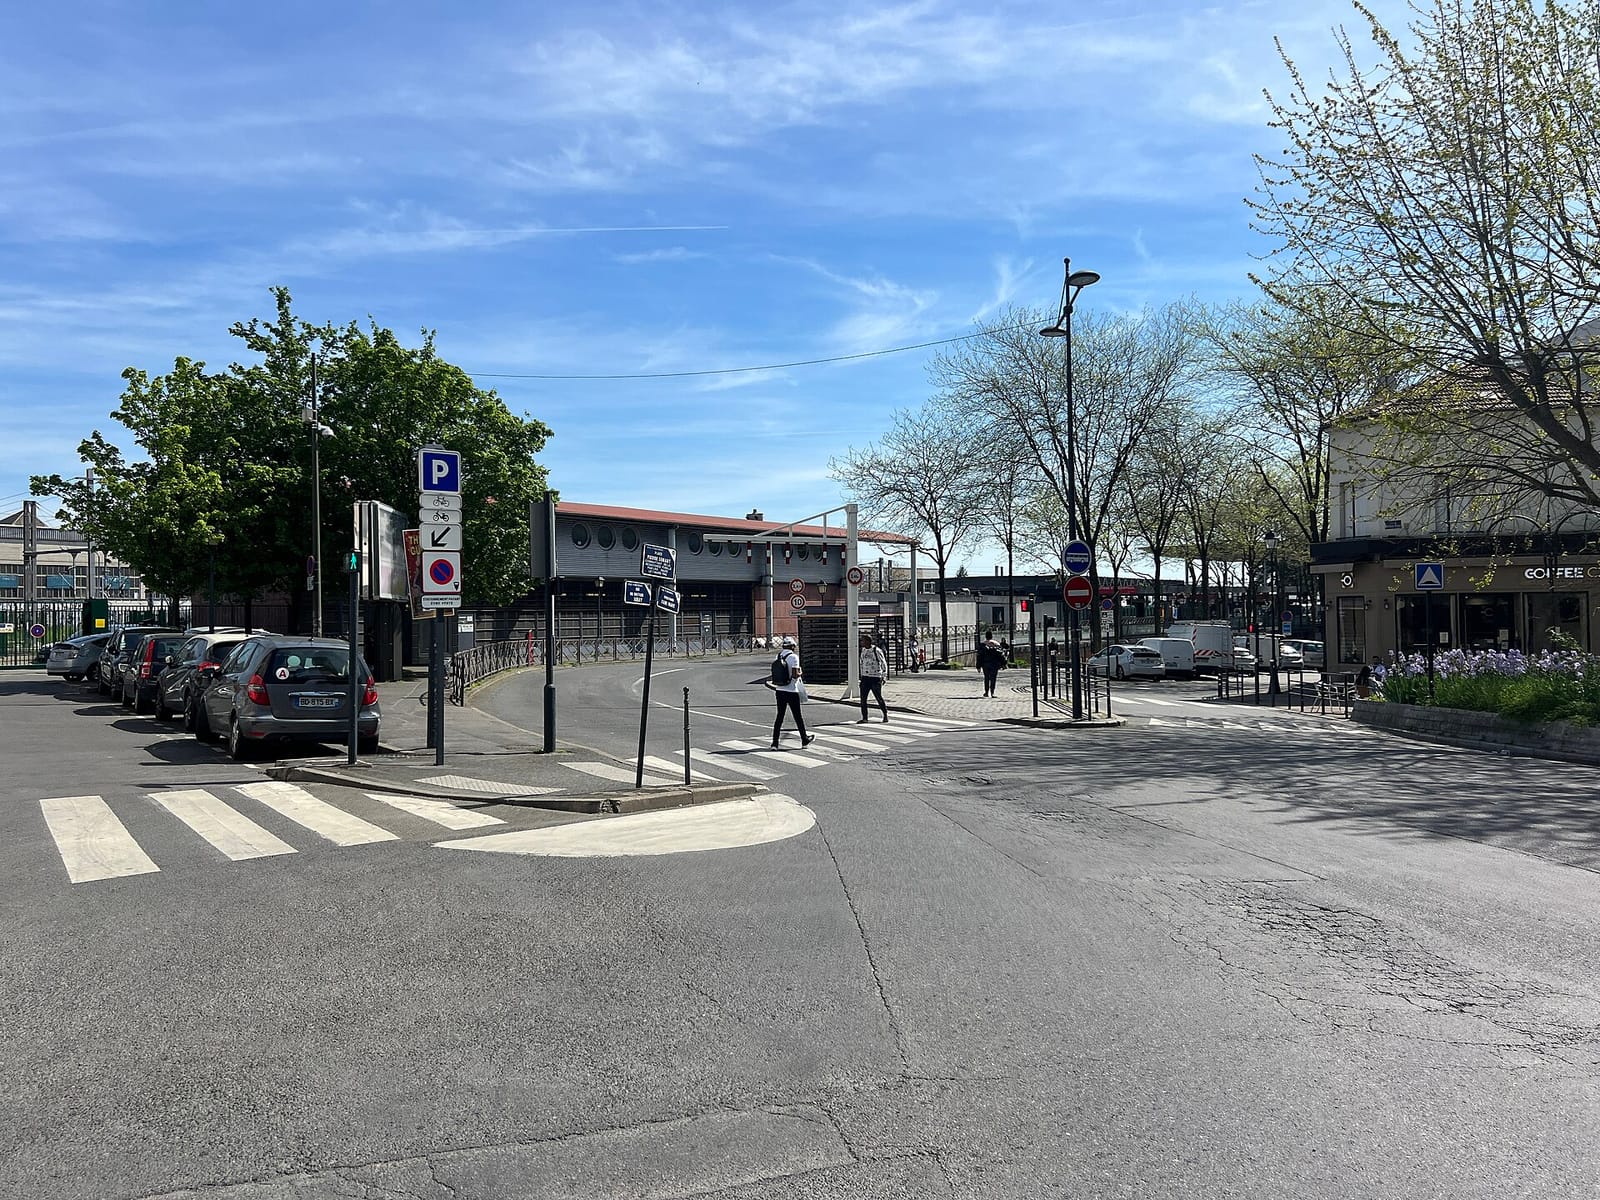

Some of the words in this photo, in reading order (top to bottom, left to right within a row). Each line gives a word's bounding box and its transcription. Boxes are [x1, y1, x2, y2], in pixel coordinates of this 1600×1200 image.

[432, 459, 449, 485] P
[1524, 568, 1584, 579] COFFEE
[794, 598, 802, 606] 10
[279, 670, 287, 678] A
